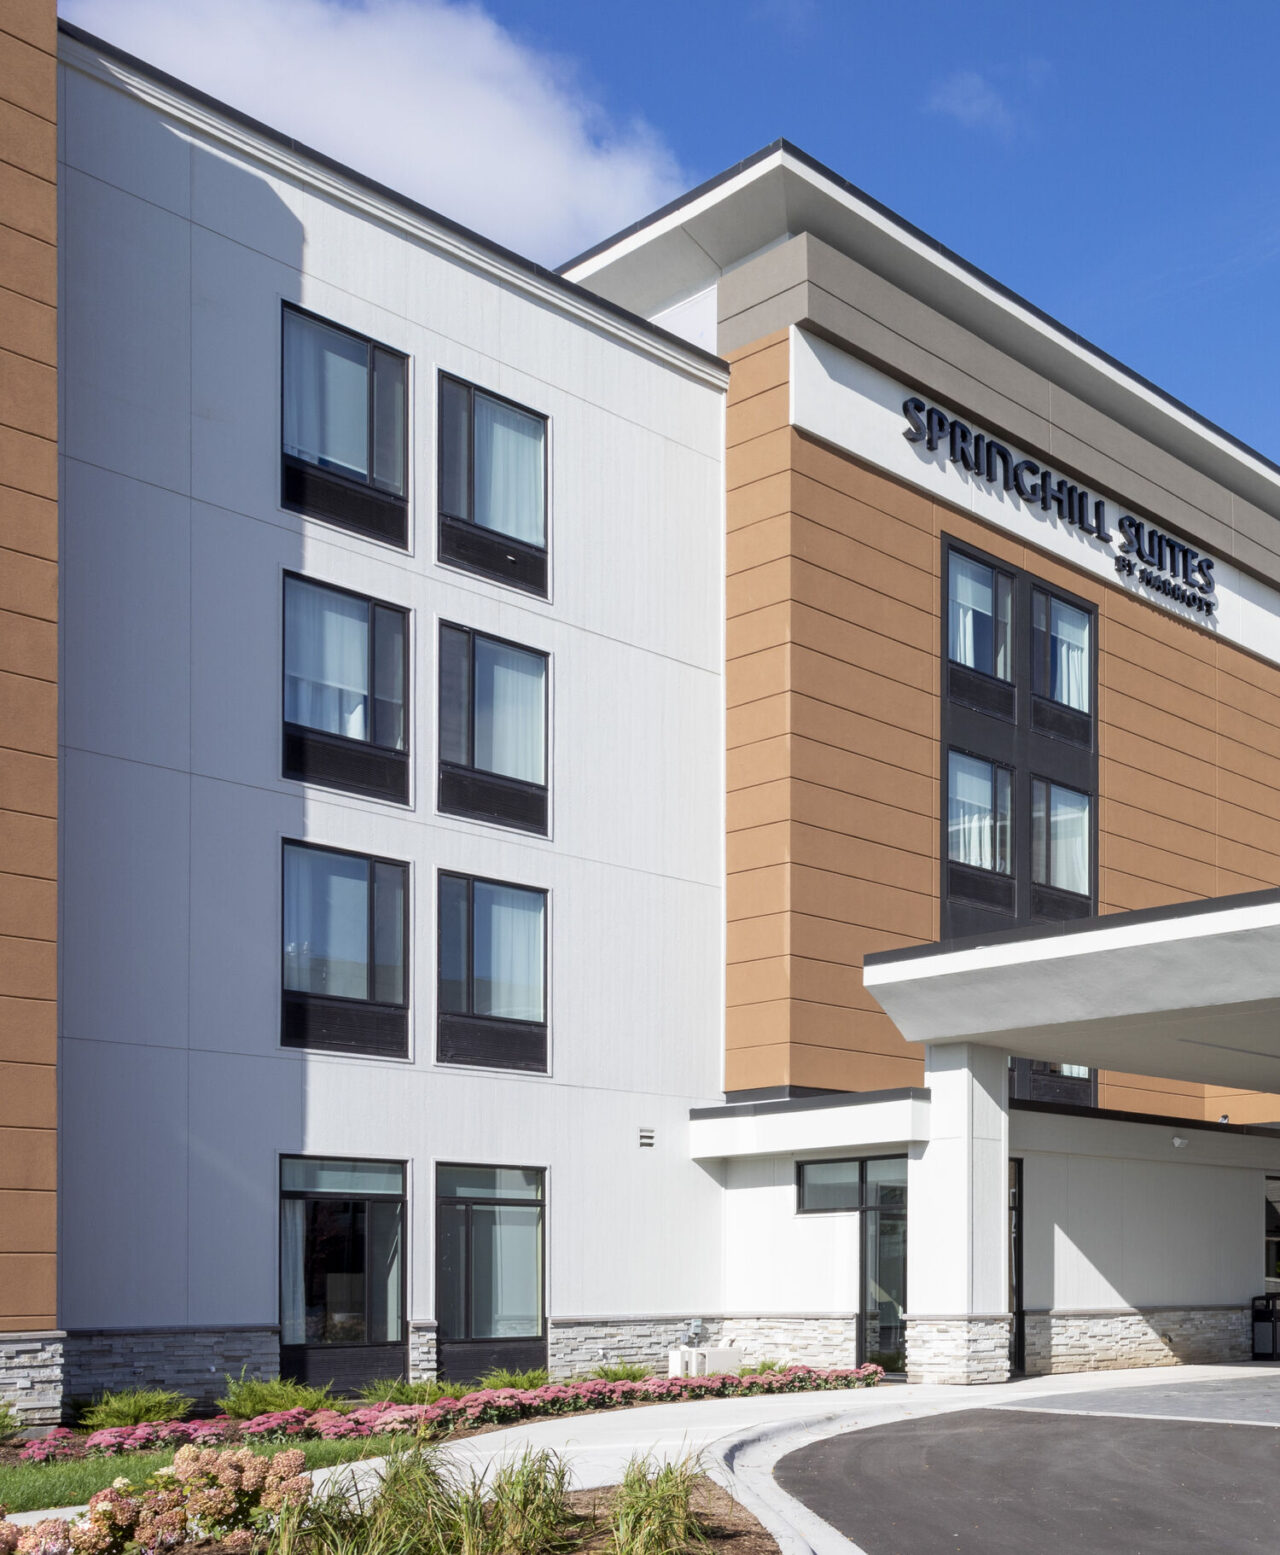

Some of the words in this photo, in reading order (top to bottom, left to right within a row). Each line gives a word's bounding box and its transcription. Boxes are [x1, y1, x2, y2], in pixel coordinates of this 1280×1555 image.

[902, 397, 1112, 543] SPRINGHILL
[1118, 515, 1215, 595] SUITES
[1115, 555, 1137, 576] BY
[1139, 567, 1215, 616] MARRIOTT
